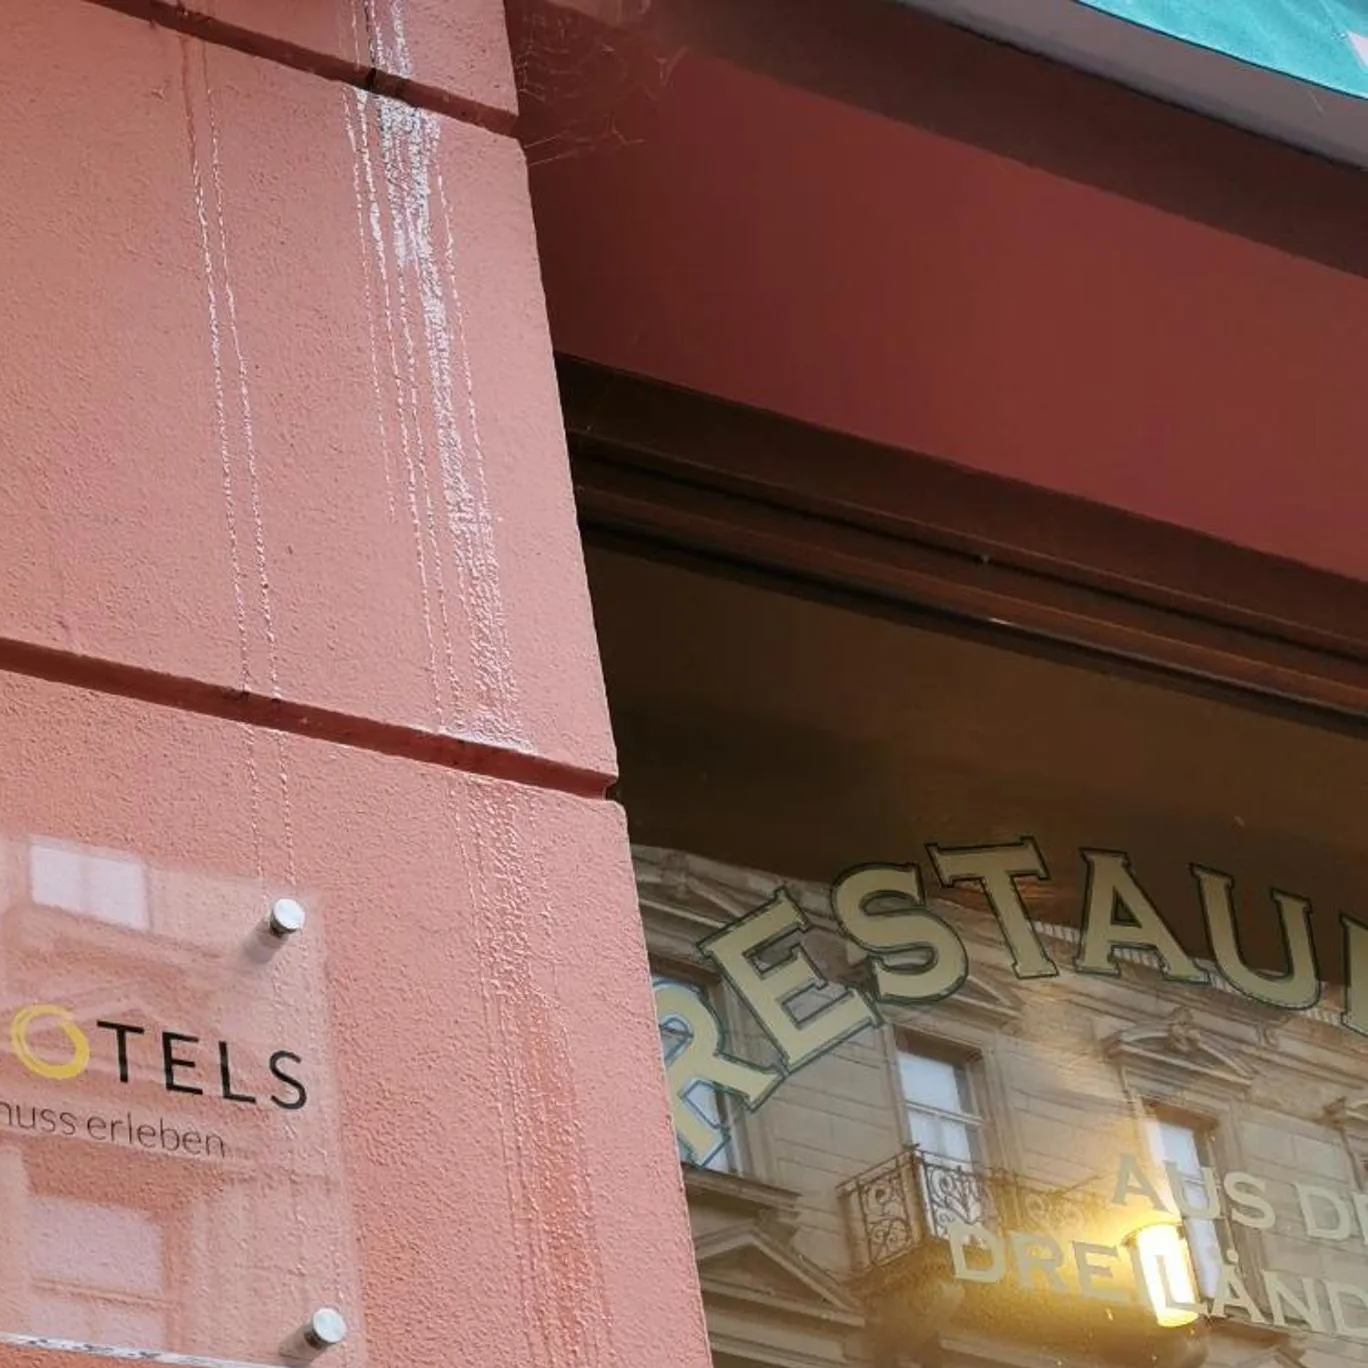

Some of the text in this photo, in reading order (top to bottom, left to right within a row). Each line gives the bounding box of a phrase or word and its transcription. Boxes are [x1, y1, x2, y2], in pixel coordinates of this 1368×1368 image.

[86, 1112, 228, 1160] erleben
[1111, 1153, 1368, 1246] AUS D
